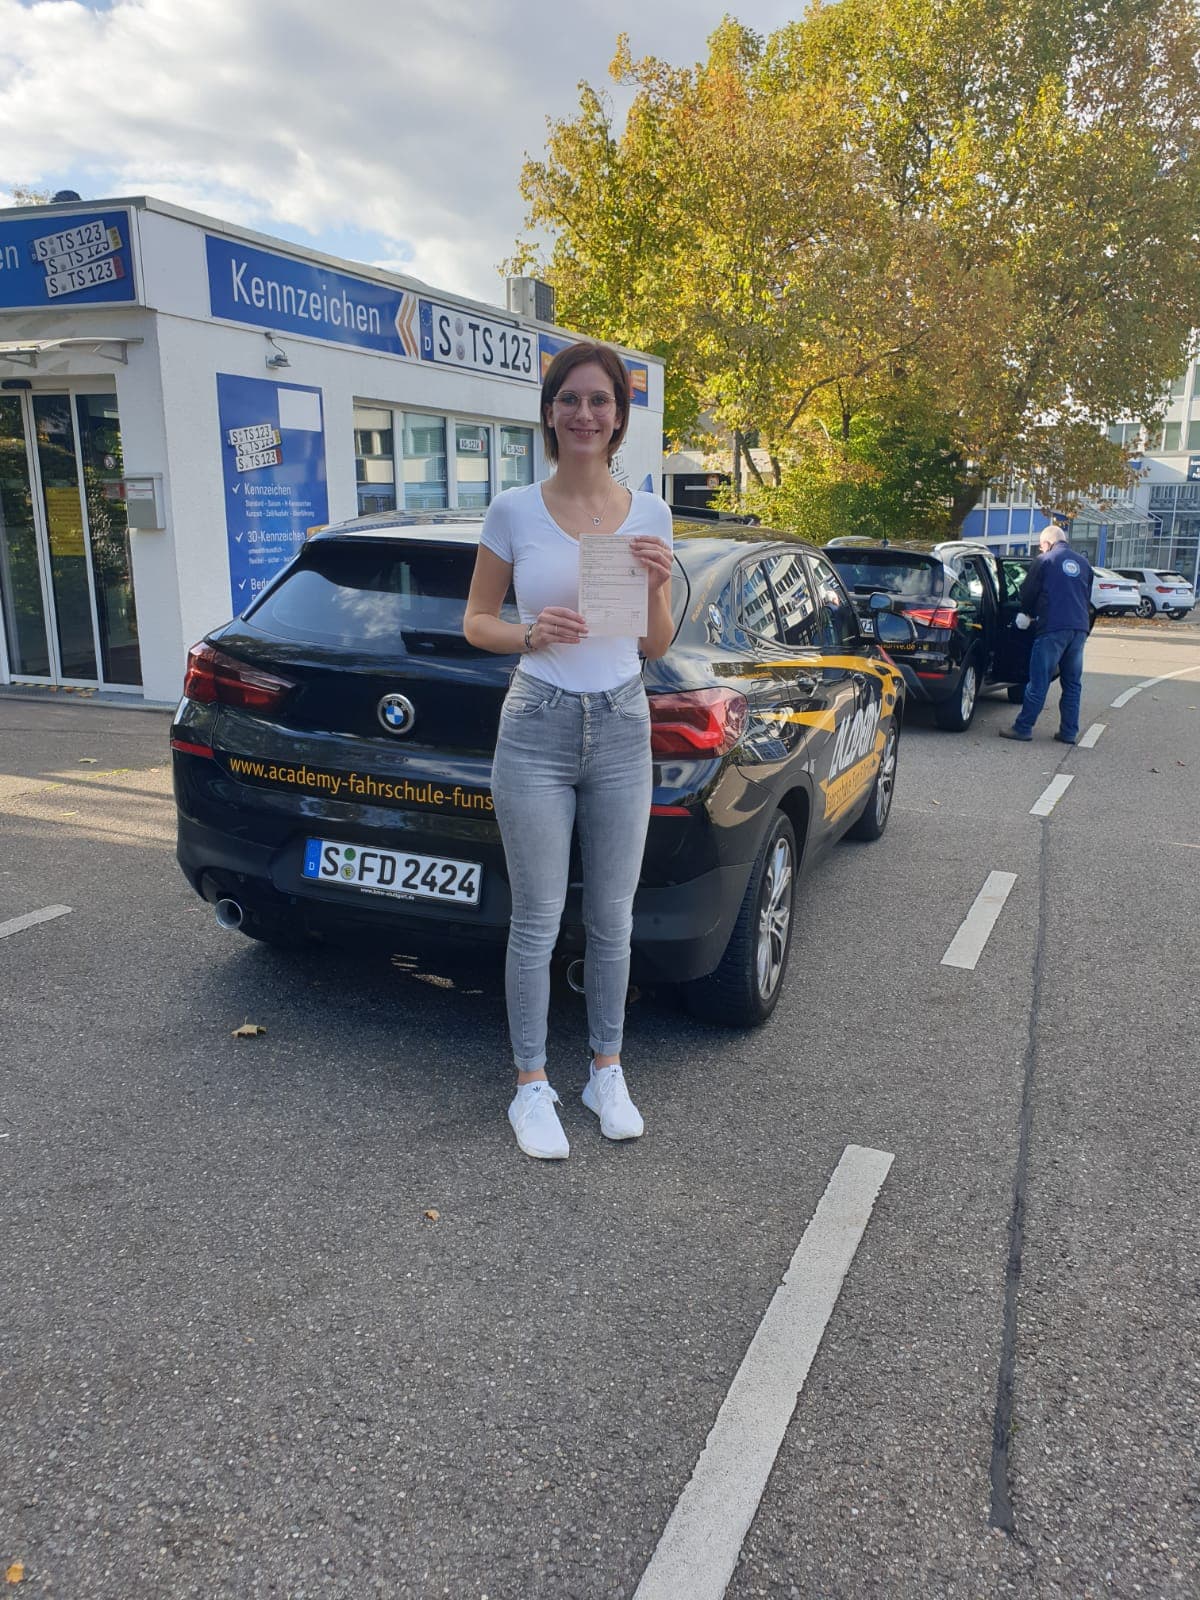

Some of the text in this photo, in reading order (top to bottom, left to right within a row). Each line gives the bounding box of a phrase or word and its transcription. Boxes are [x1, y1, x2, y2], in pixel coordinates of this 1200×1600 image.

[39, 241, 48, 257] S
[56, 233, 75, 252] TS
[76, 224, 102, 246] 123
[50, 278, 59, 294] S
[68, 270, 86, 288] TS
[88, 261, 113, 283] 123
[230, 258, 381, 335] Kennzeichen
[424, 336, 432, 351] D
[439, 315, 451, 356] S
[469, 322, 494, 365] TS
[499, 331, 532, 373] 123
[244, 483, 291, 495] Kennzeichen
[321, 846, 340, 876] S
